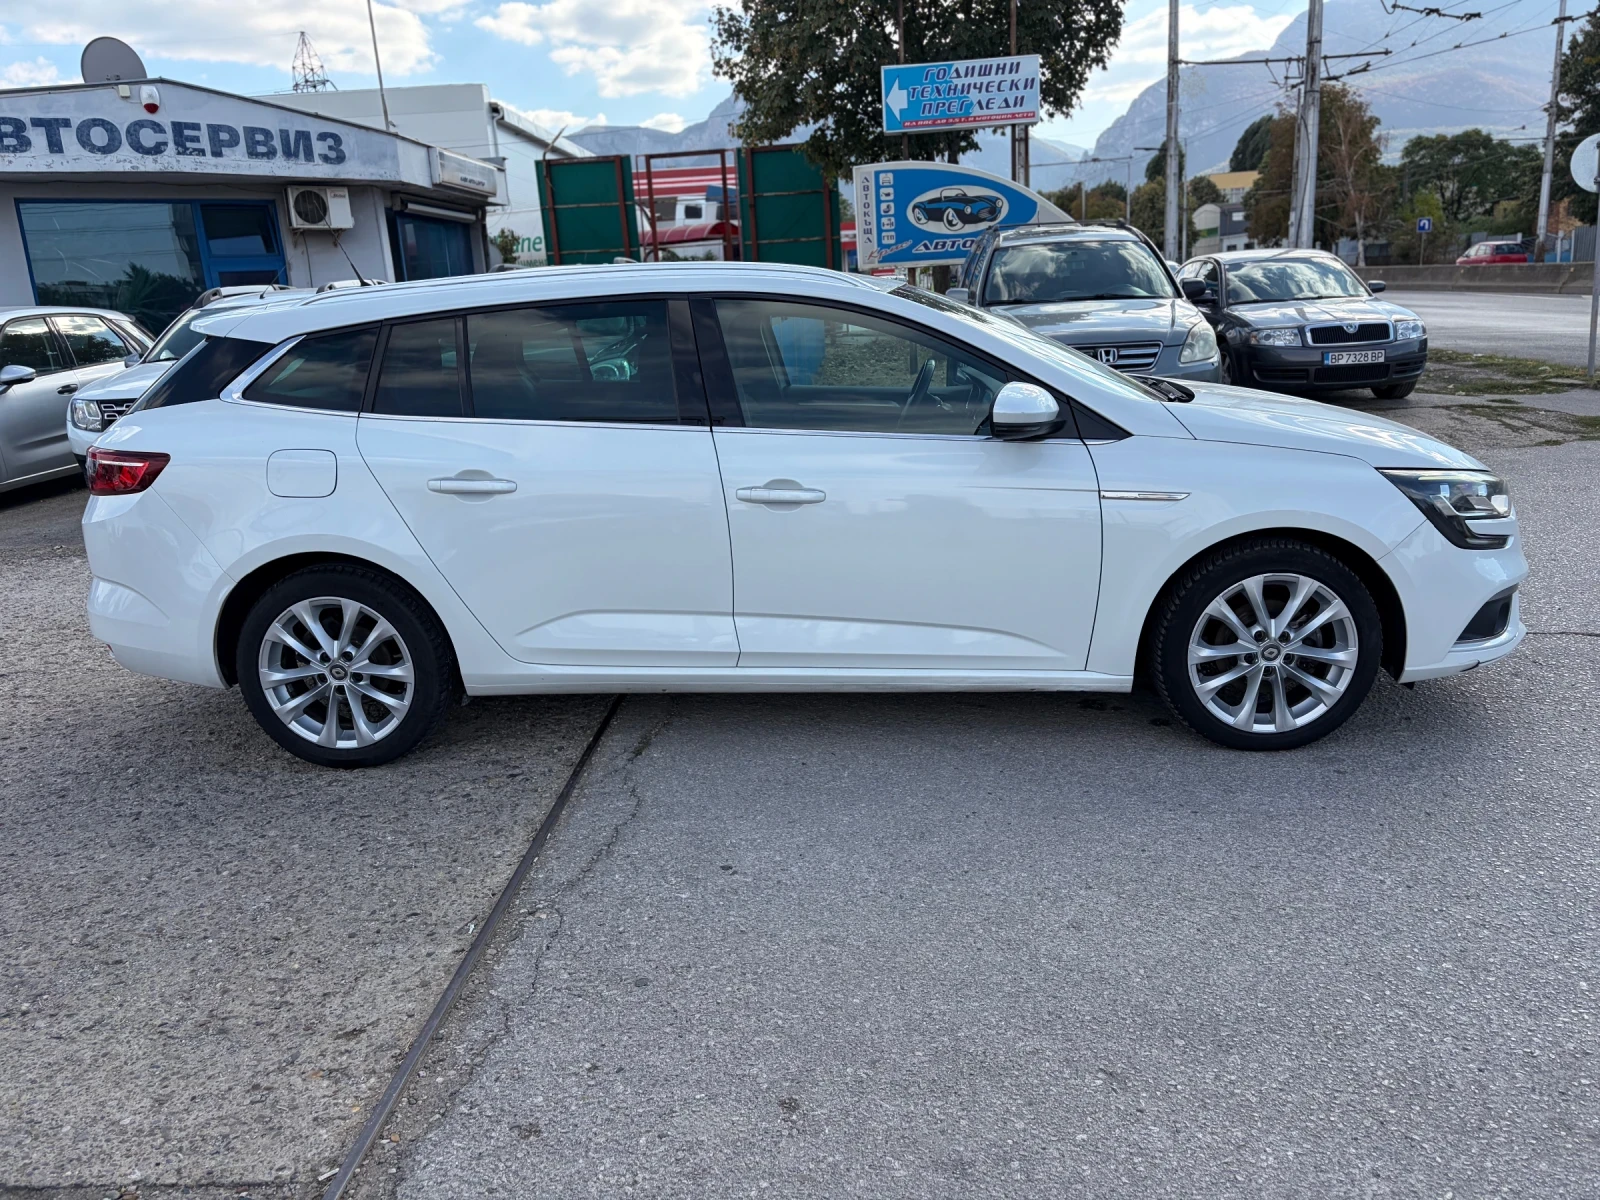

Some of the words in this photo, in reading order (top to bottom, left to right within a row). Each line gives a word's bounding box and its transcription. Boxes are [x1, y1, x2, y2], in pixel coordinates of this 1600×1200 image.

[924, 61, 1021, 81] ГОДИШНИ
[909, 77, 1035, 100] ТЕХНИЧЕСКИ
[920, 95, 1025, 116] ПРЕГЛЕДИ
[862, 176, 873, 243] АВТОКЪЩА
[1345, 353, 1369, 363] 7328
